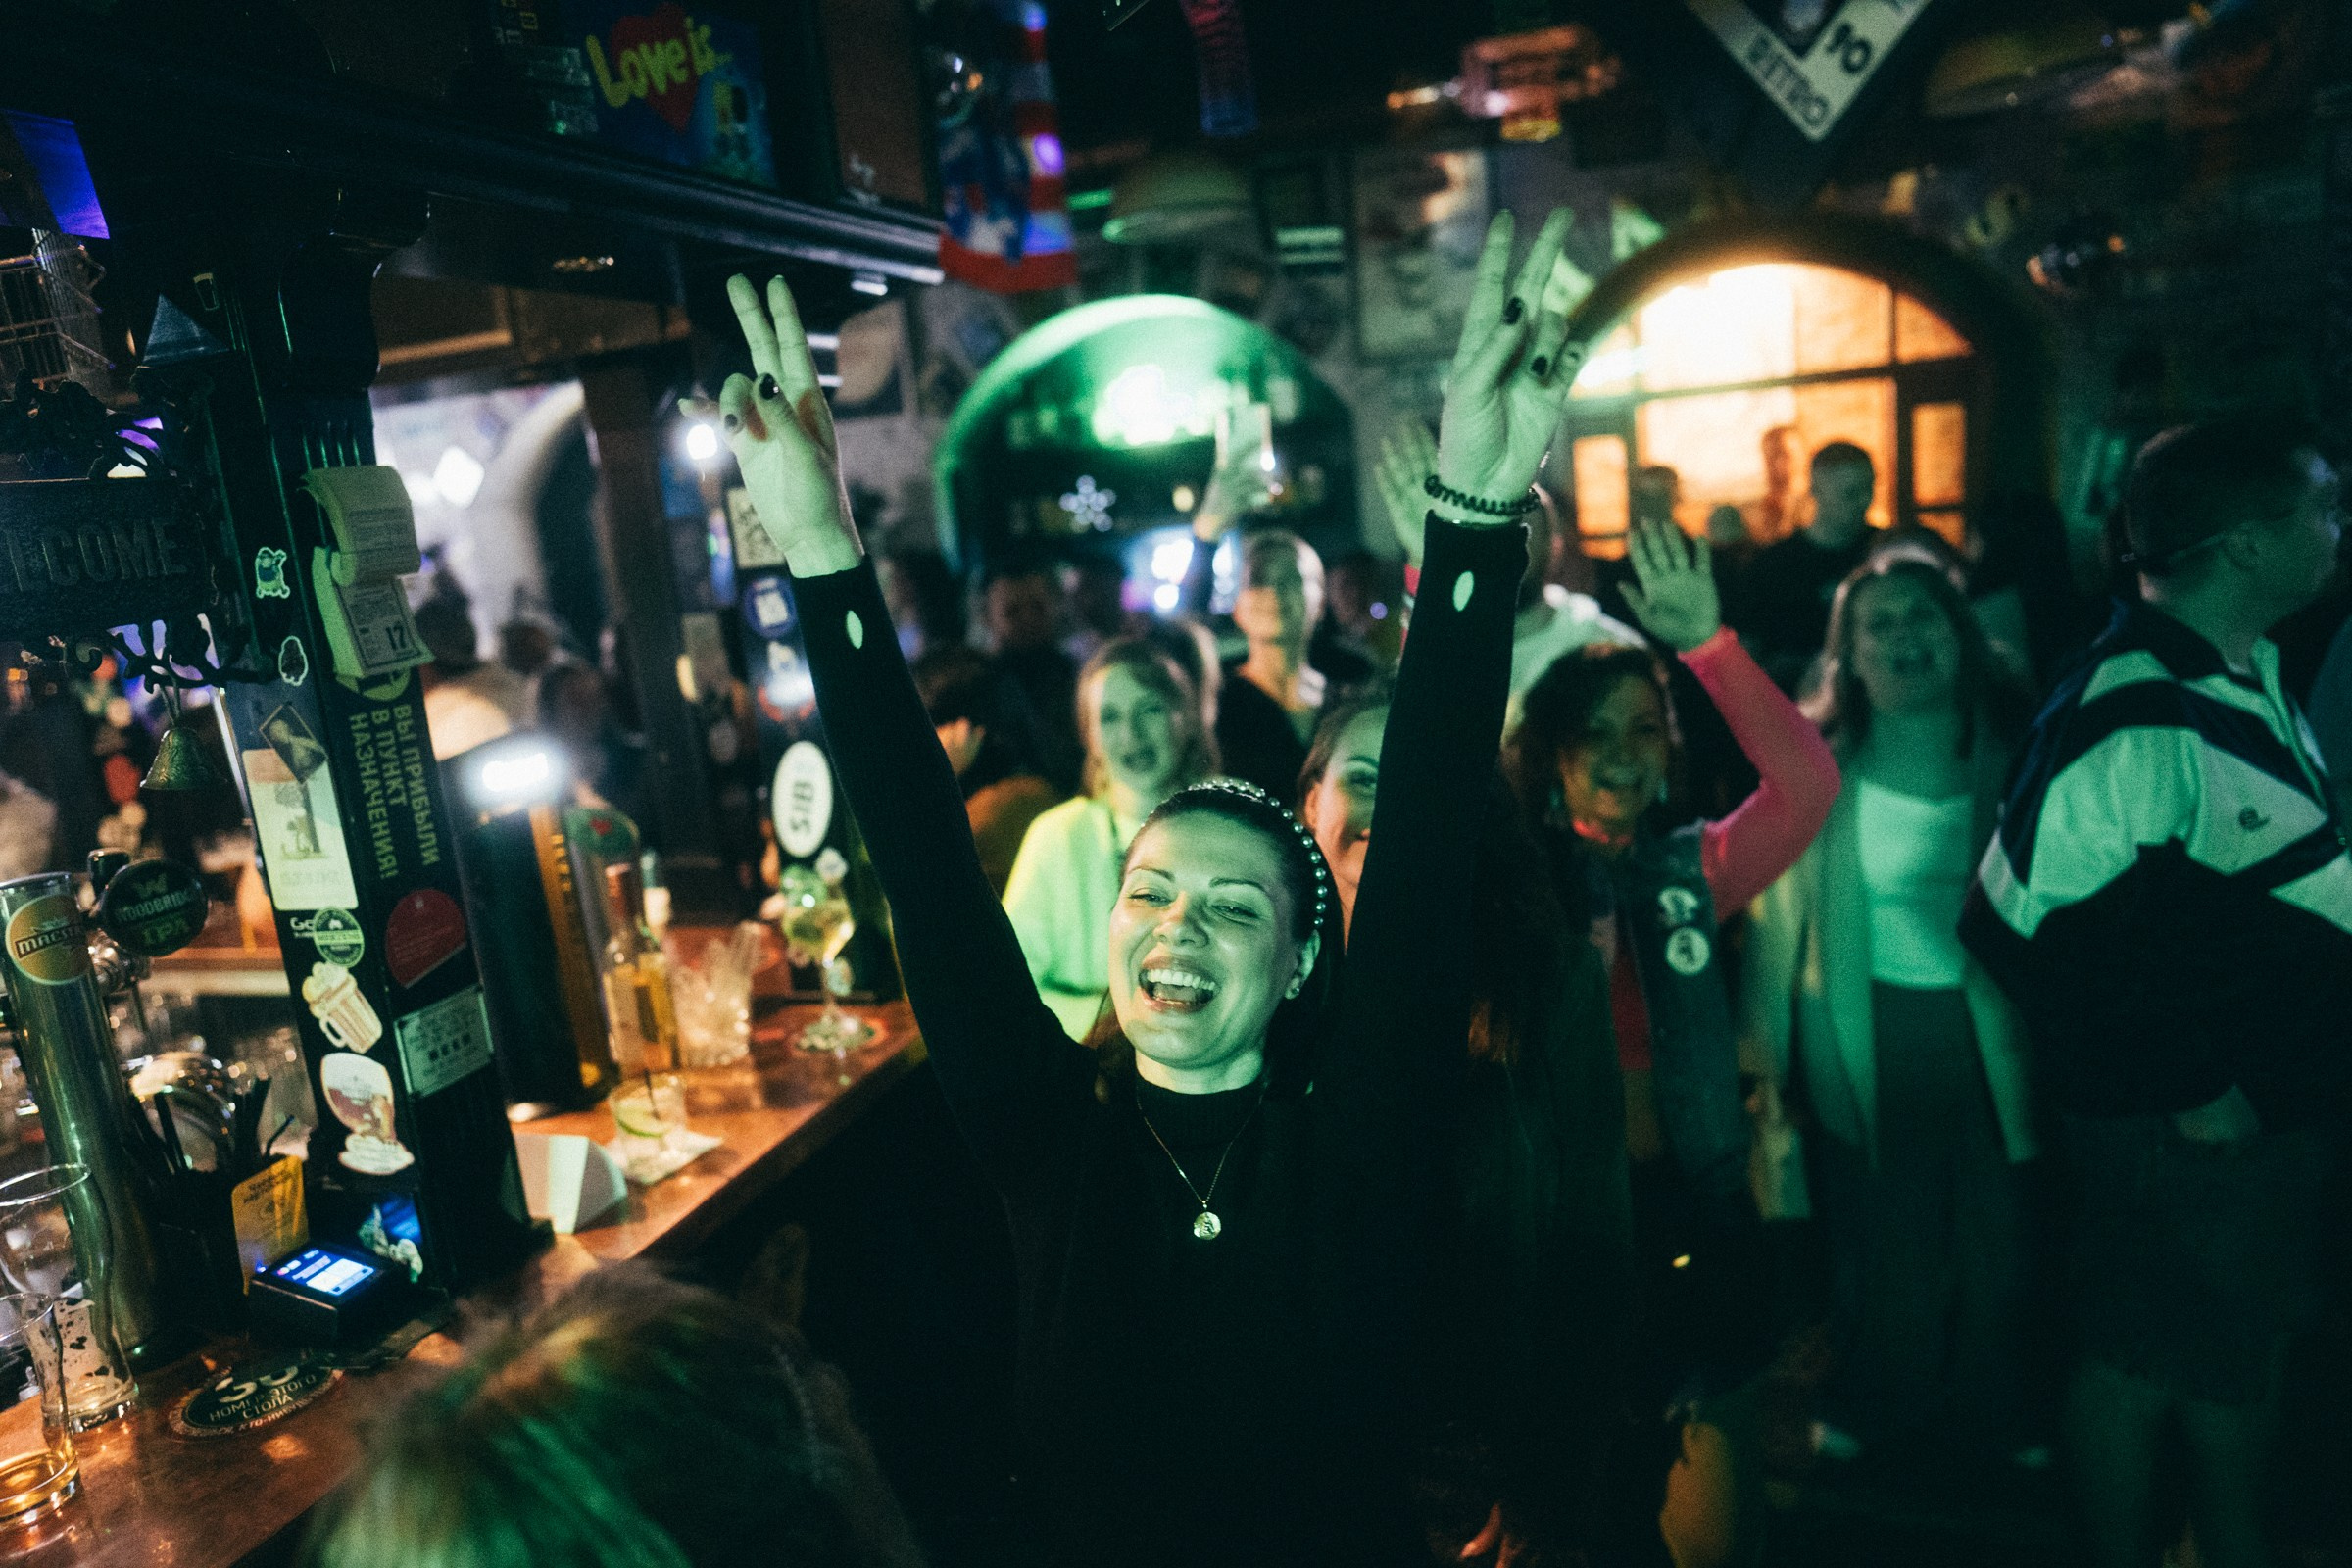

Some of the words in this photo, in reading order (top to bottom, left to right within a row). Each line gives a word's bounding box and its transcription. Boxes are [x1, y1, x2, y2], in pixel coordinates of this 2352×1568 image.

[586, 34, 689, 108] Love
[385, 619, 407, 650] 17
[371, 708, 390, 724] В
[393, 704, 416, 742] ВЫ
[349, 712, 399, 880] НАЗНАЧЕНИЯ!
[376, 730, 408, 806] ПУНКТ
[402, 747, 440, 866] ПРИБЫЛИ
[242, 1394, 294, 1420] СТОЛА
